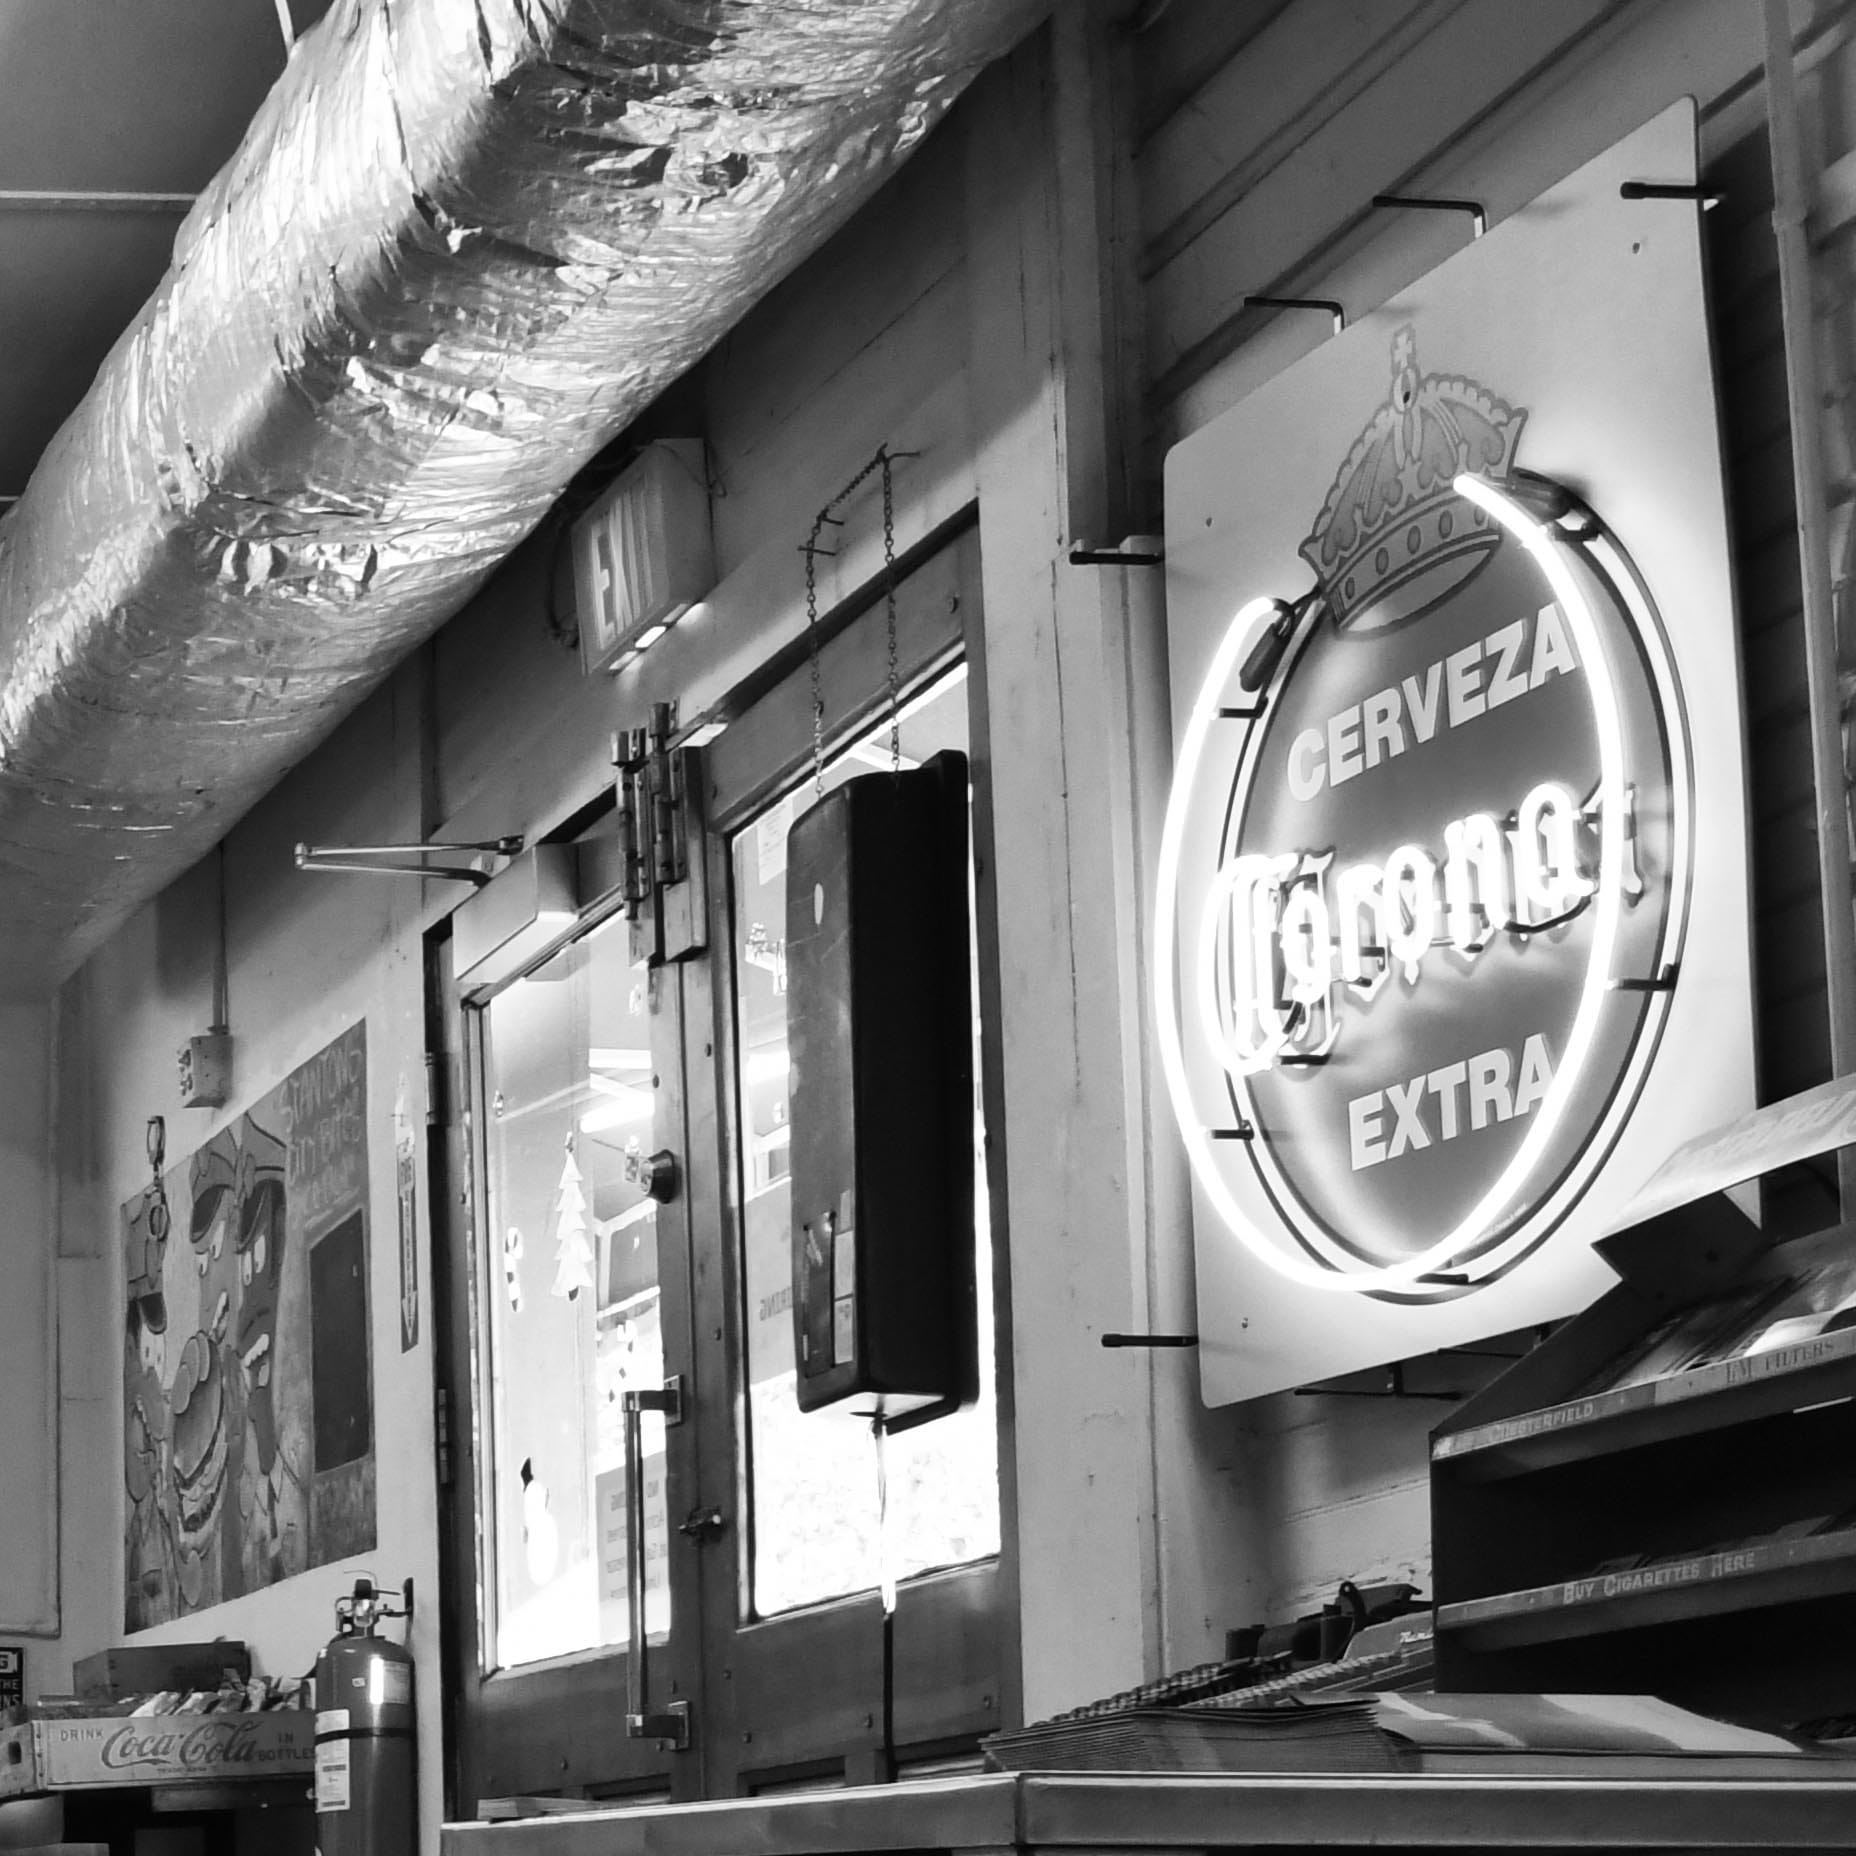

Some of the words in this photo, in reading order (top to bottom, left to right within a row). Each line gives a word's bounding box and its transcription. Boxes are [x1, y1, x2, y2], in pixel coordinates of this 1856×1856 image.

[1287, 603, 1578, 802] CERVEZA
[1348, 1033, 1555, 1172] EXTRA
[1563, 1581, 1595, 1605] BUY
[1603, 1558, 1701, 1597] CIGARETTES
[1710, 1550, 1756, 1578] HERE
[60, 1728, 105, 1742] DRINK
[101, 1720, 265, 1769] Coca-Cola
[277, 1733, 295, 1745] IN
